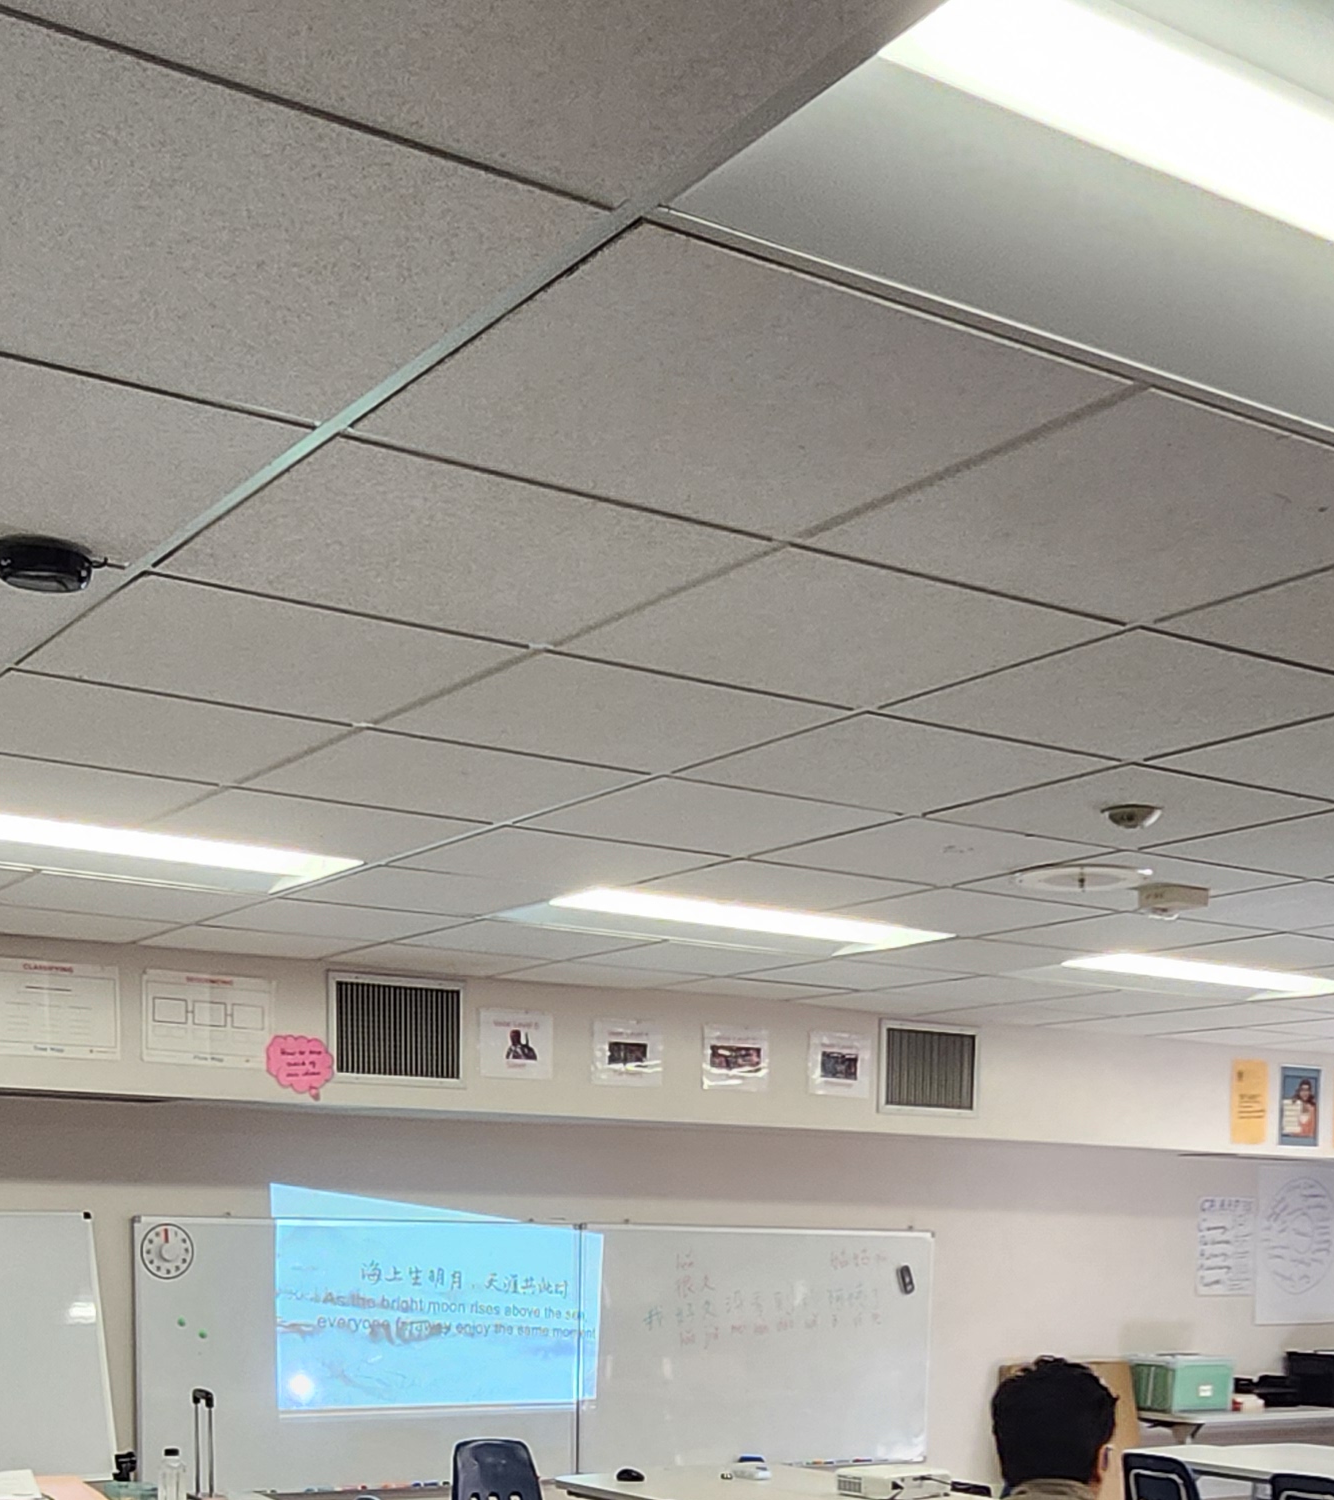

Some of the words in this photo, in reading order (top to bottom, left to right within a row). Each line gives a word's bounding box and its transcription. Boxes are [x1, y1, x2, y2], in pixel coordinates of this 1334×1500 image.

[323, 1292, 347, 1306] As
[381, 1295, 424, 1313] bright
[427, 1301, 466, 1314] moon
[470, 1301, 500, 1315] rises
[504, 1304, 540, 1318] above
[544, 1306, 562, 1320] the
[456, 1323, 490, 1338] enjoy
[494, 1324, 513, 1335] the
[518, 1326, 550, 1337] same
